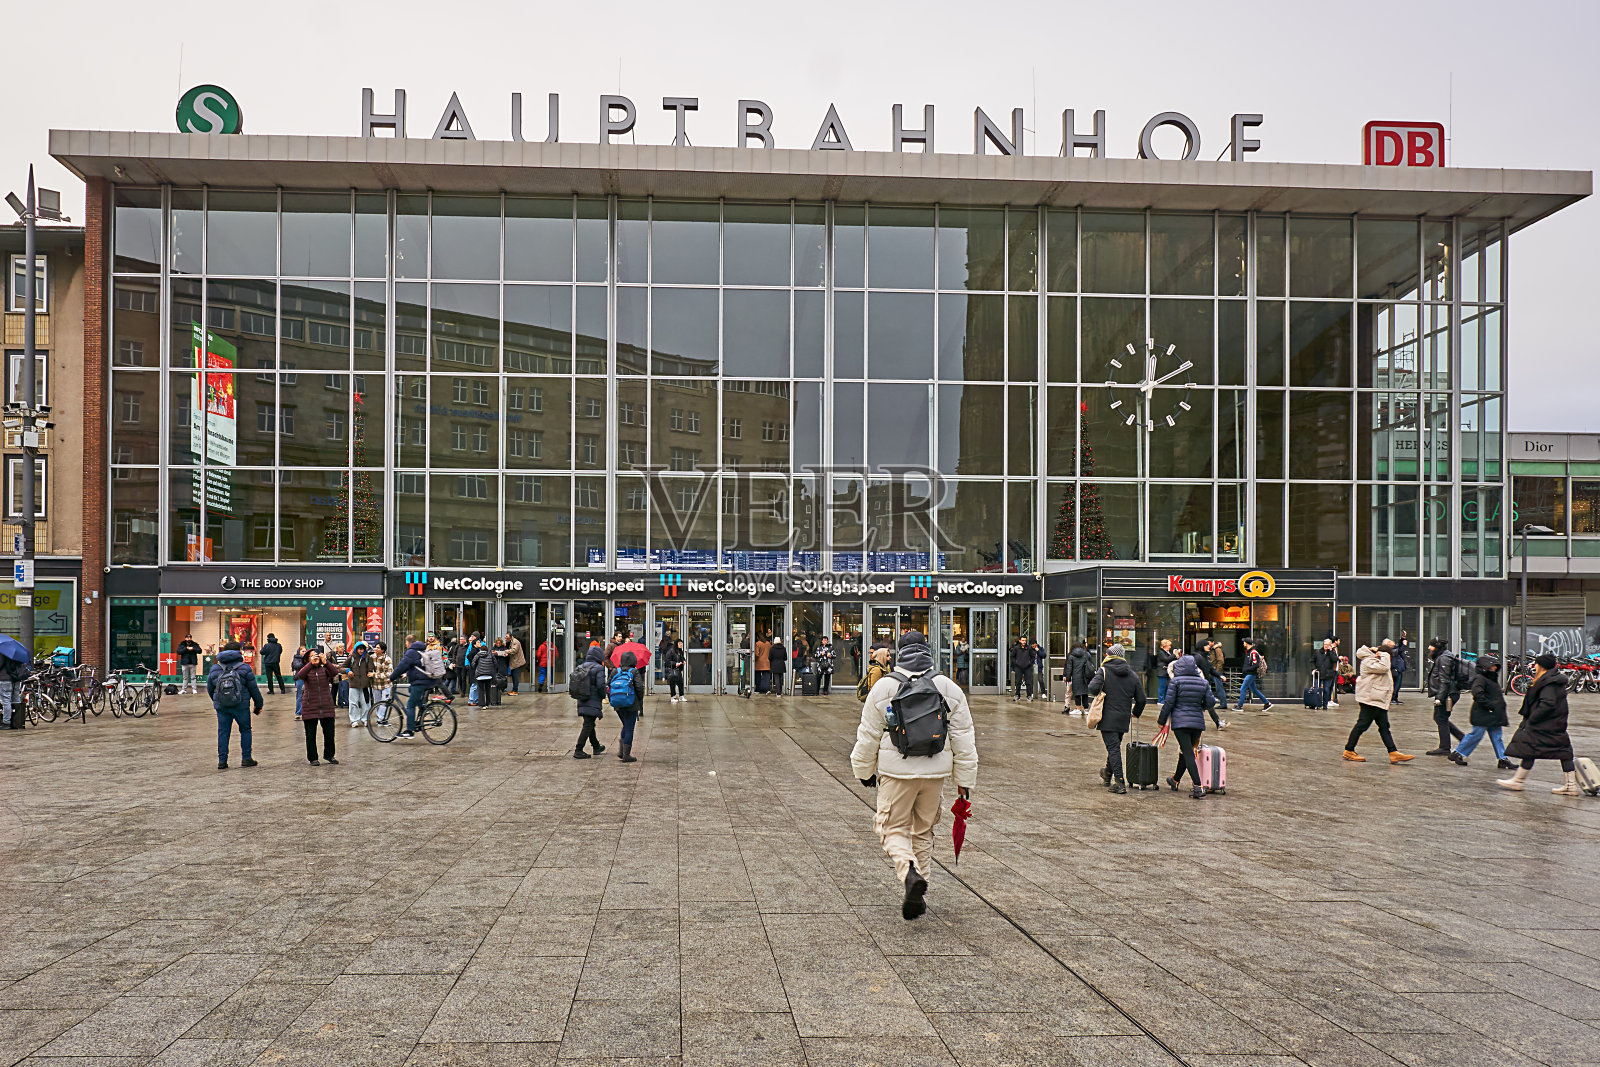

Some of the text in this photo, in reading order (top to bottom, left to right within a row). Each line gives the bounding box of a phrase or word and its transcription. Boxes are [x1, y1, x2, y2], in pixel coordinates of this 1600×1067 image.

[361, 87, 1264, 163] HAUPTBAHNHOF
[1373, 129, 1434, 168] DB
[1524, 440, 1554, 452] Dior
[1414, 500, 1519, 522] DOGAS
[240, 578, 324, 589] THE BODY SHOP
[433, 577, 645, 594] NetCologne Highspeed
[687, 579, 895, 596] NetCologne Highspeed
[937, 581, 1024, 597] NetCologne
[1167, 574, 1236, 597] Kamps
[0, 593, 50, 607] Chge
